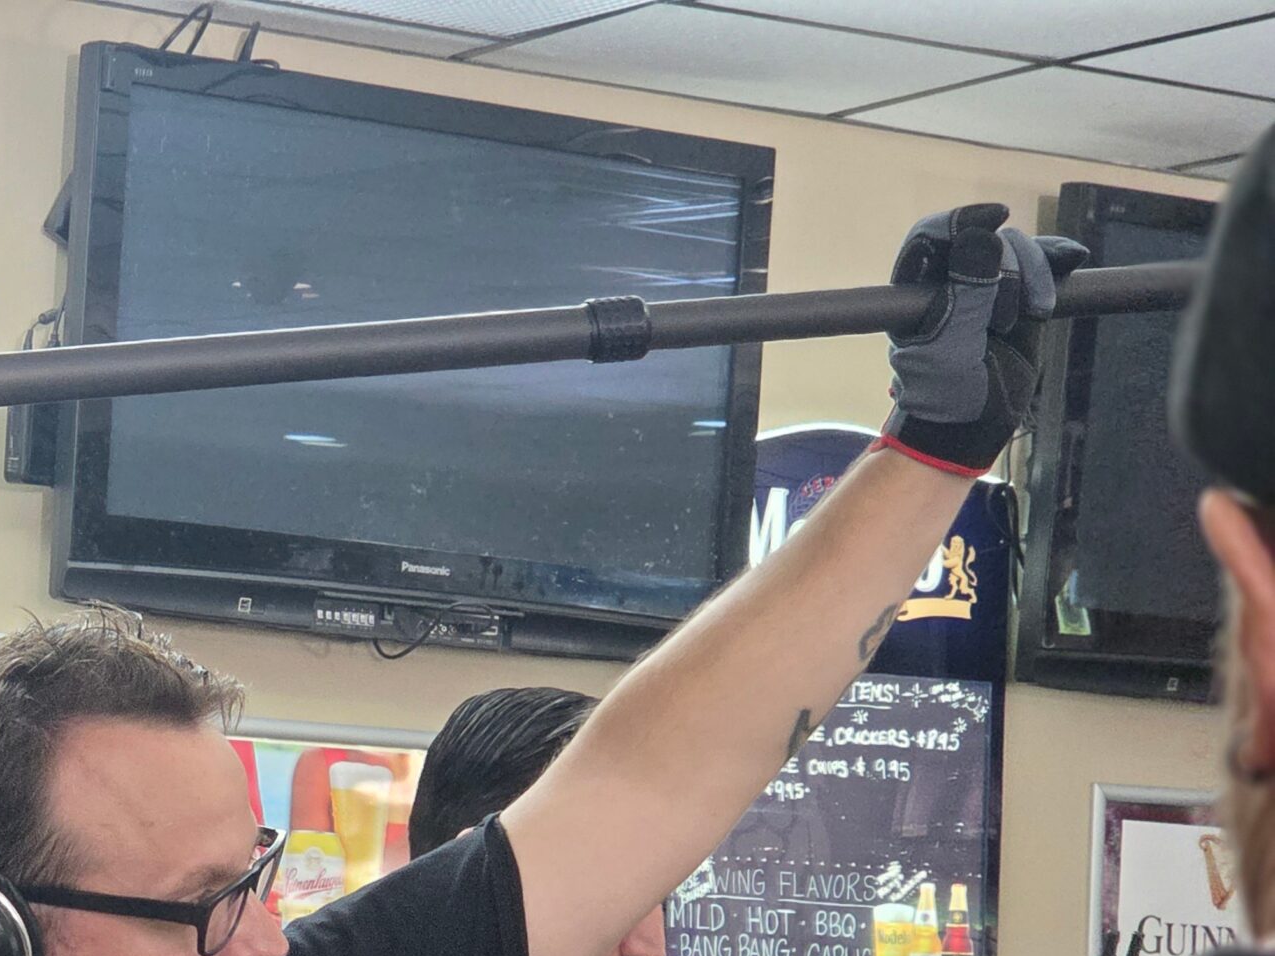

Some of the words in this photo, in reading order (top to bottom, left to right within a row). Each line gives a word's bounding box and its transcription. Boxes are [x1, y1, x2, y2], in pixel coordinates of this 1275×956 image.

[400, 560, 451, 577] Panasonic
[839, 681, 901, 704] TEMS!
[713, 867, 766, 896] WING
[780, 871, 877, 902] FLAVORS
[669, 898, 726, 932] MILD
[748, 905, 797, 936] HOT
[815, 910, 857, 940] BBQ
